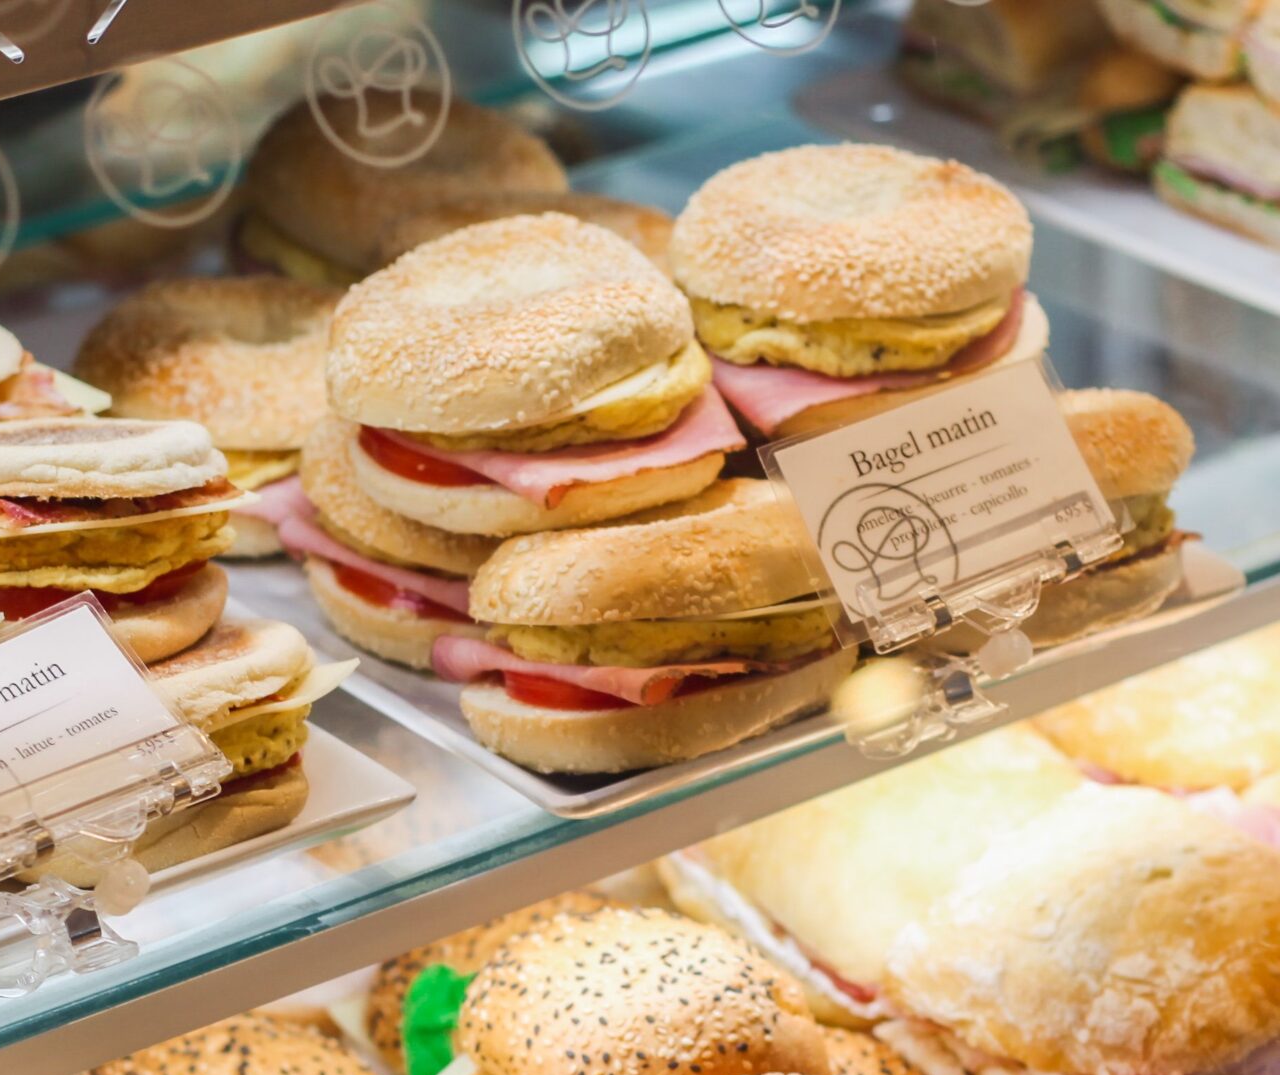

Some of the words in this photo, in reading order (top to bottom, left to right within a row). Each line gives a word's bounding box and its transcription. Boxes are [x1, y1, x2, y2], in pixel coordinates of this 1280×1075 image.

[849, 433, 921, 478] Bagel
[926, 406, 999, 449] matin
[856, 502, 913, 534] omelette
[924, 479, 969, 506] beurre
[980, 456, 1032, 486] tomates
[889, 512, 958, 551] provolone
[970, 485, 1029, 517] capicollo
[1055, 504, 1081, 524] 6,95
[19, 736, 56, 760] laitue
[65, 705, 119, 736] tomates
